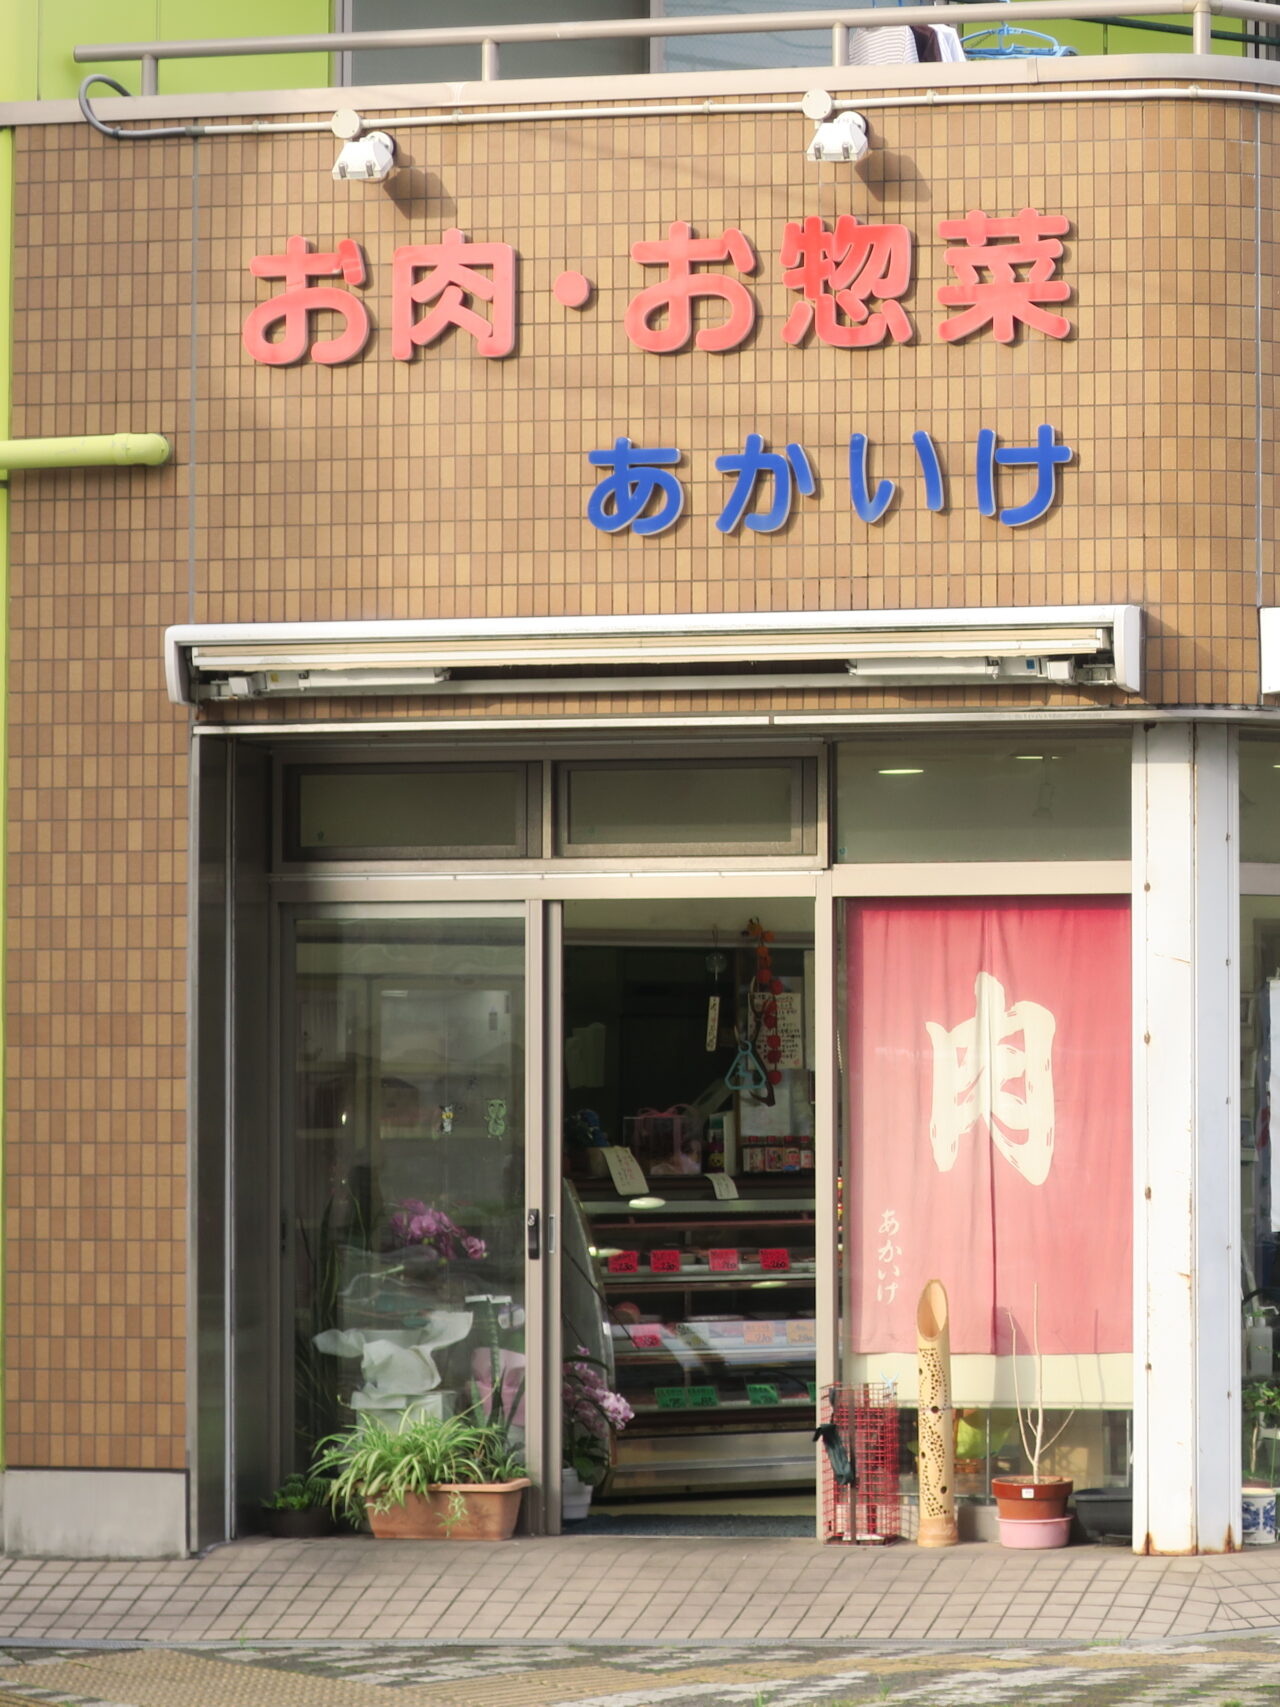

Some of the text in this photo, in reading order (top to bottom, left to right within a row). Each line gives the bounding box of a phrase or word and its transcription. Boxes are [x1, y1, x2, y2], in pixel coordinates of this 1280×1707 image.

[243, 207, 1071, 366] お肉・お惣菜
[587, 424, 1074, 536] あかいけ
[925, 971, 1057, 1186] 肉
[877, 1209, 902, 1305] あかいけ
